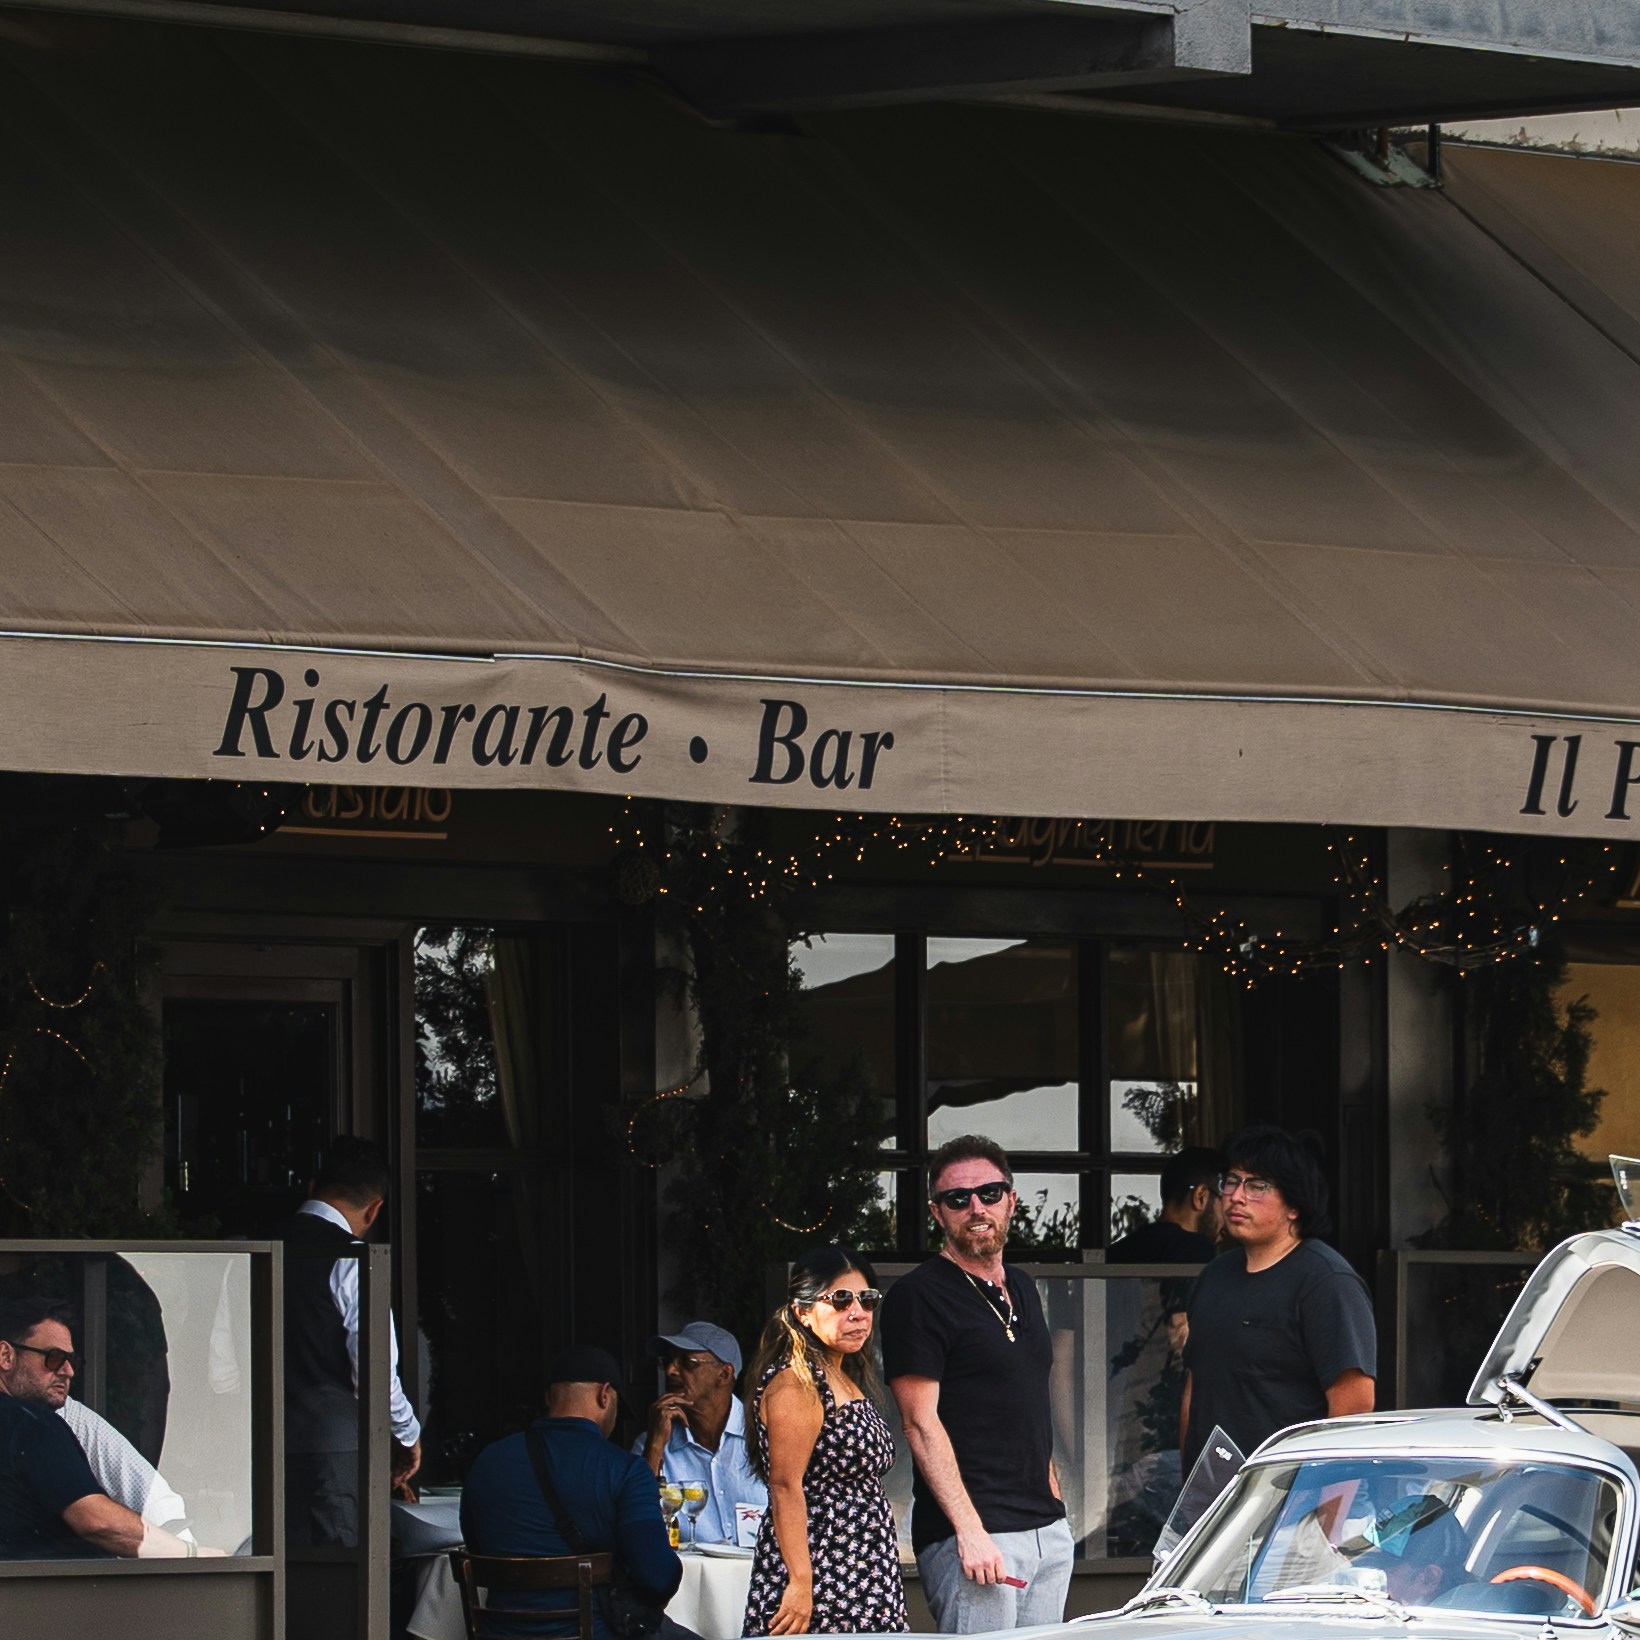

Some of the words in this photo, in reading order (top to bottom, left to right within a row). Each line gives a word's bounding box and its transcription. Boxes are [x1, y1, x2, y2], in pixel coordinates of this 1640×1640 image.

[213, 665, 649, 774] Ristorante
[749, 698, 894, 790] Bar
[1520, 734, 1582, 818] Il
